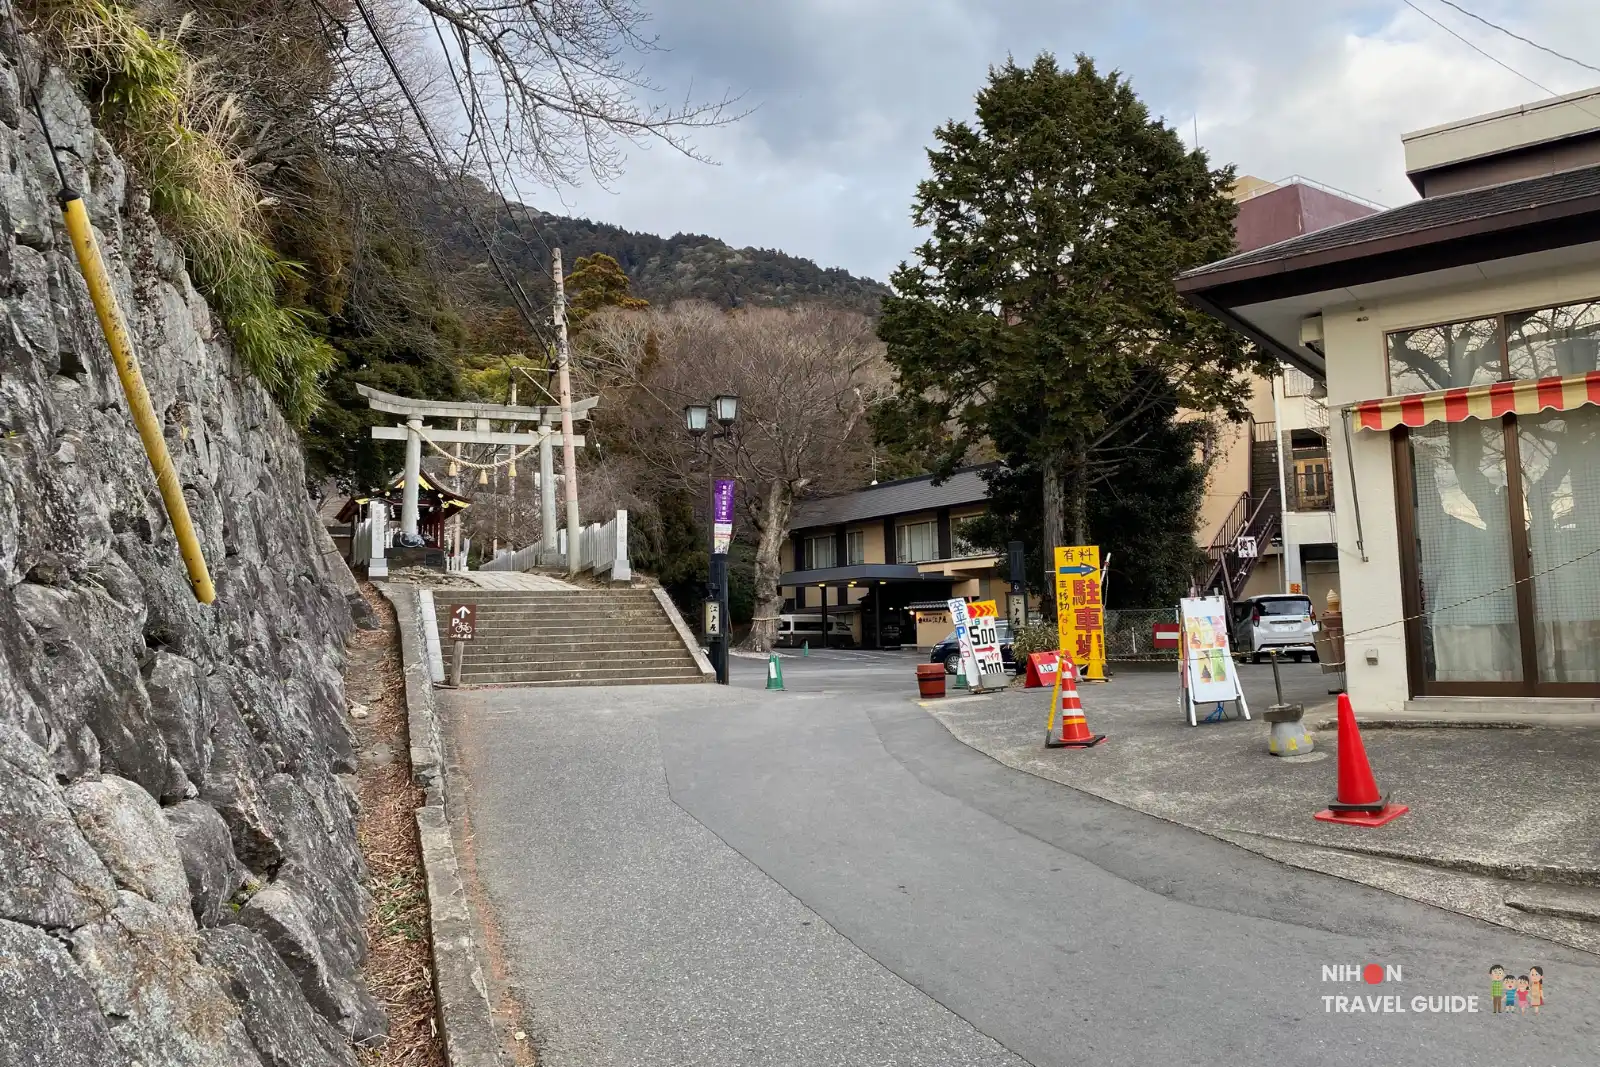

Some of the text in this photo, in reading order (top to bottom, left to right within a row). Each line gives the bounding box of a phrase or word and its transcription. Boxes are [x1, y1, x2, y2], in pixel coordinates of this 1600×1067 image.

[1063, 548, 1094, 562] 有料
[451, 617, 460, 627] P
[1072, 578, 1103, 661] 駐車場
[968, 626, 996, 646] 500
